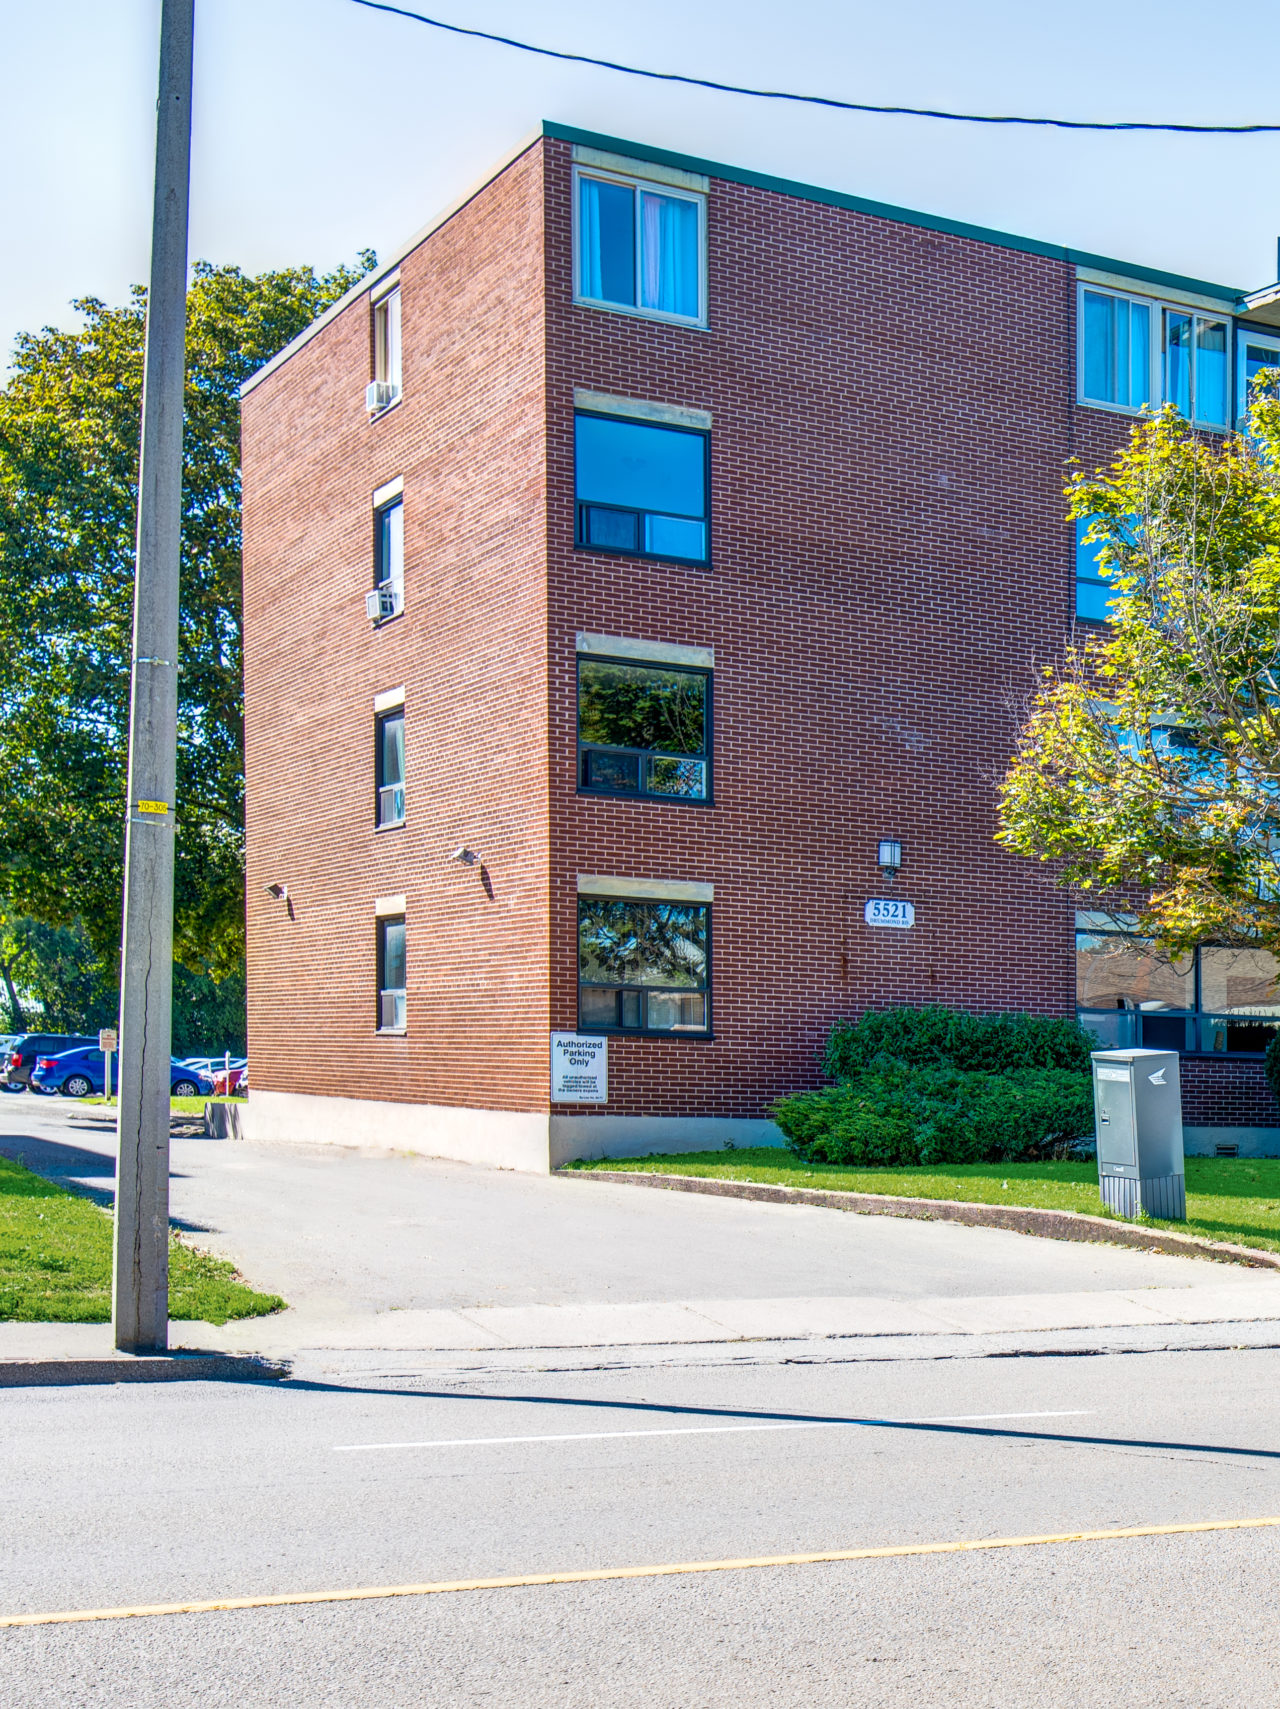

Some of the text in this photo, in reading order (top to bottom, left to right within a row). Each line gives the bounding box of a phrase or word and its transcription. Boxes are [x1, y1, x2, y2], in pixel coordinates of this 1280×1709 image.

[873, 902, 907, 918] 5521
[556, 1040, 603, 1049] Authorized
[563, 1049, 596, 1059] Parking
[569, 1057, 590, 1067] Only
